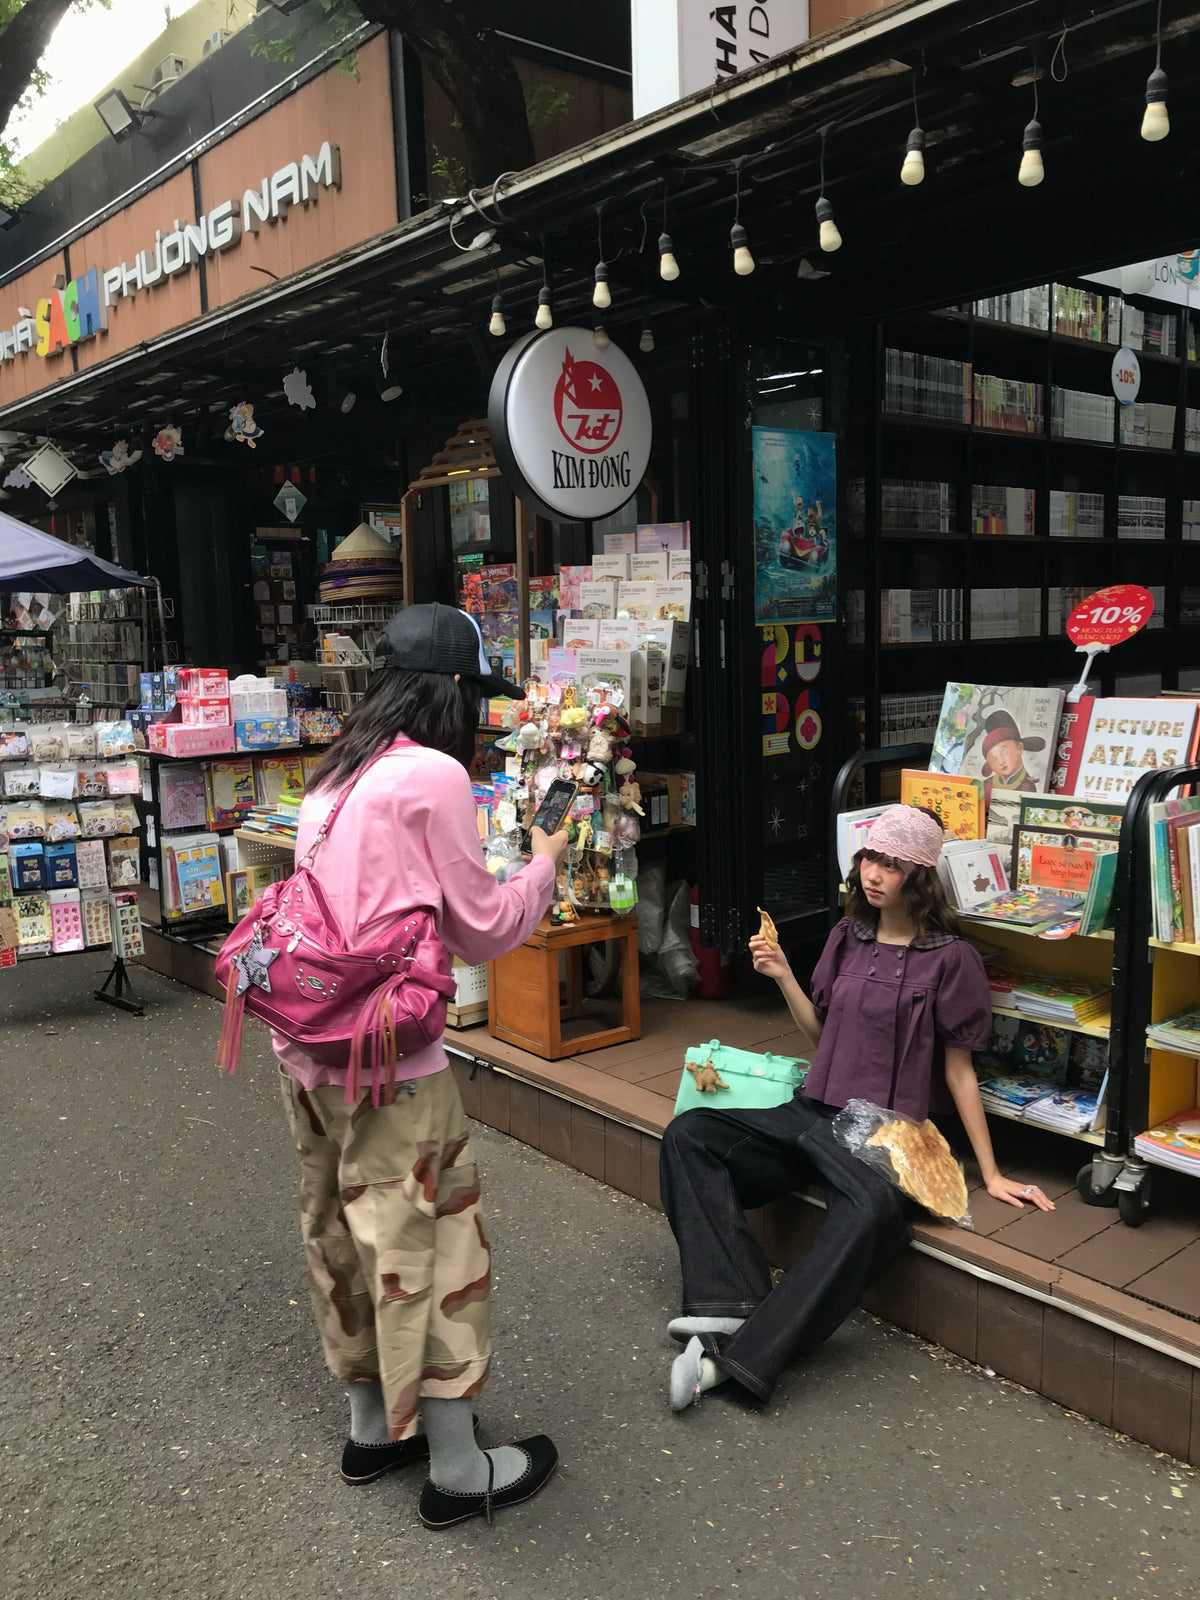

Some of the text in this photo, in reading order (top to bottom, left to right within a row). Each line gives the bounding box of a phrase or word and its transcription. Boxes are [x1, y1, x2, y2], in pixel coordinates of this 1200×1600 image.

[35, 267, 101, 357] SÁCH
[243, 141, 333, 233] NAM
[1116, 369, 1135, 385] -10%
[551, 450, 586, 489] KIM
[1076, 606, 1145, 624] -10%
[1094, 717, 1184, 738] PICTURE
[1088, 744, 1178, 768] ATLAS
[1084, 775, 1135, 792] VIETN
